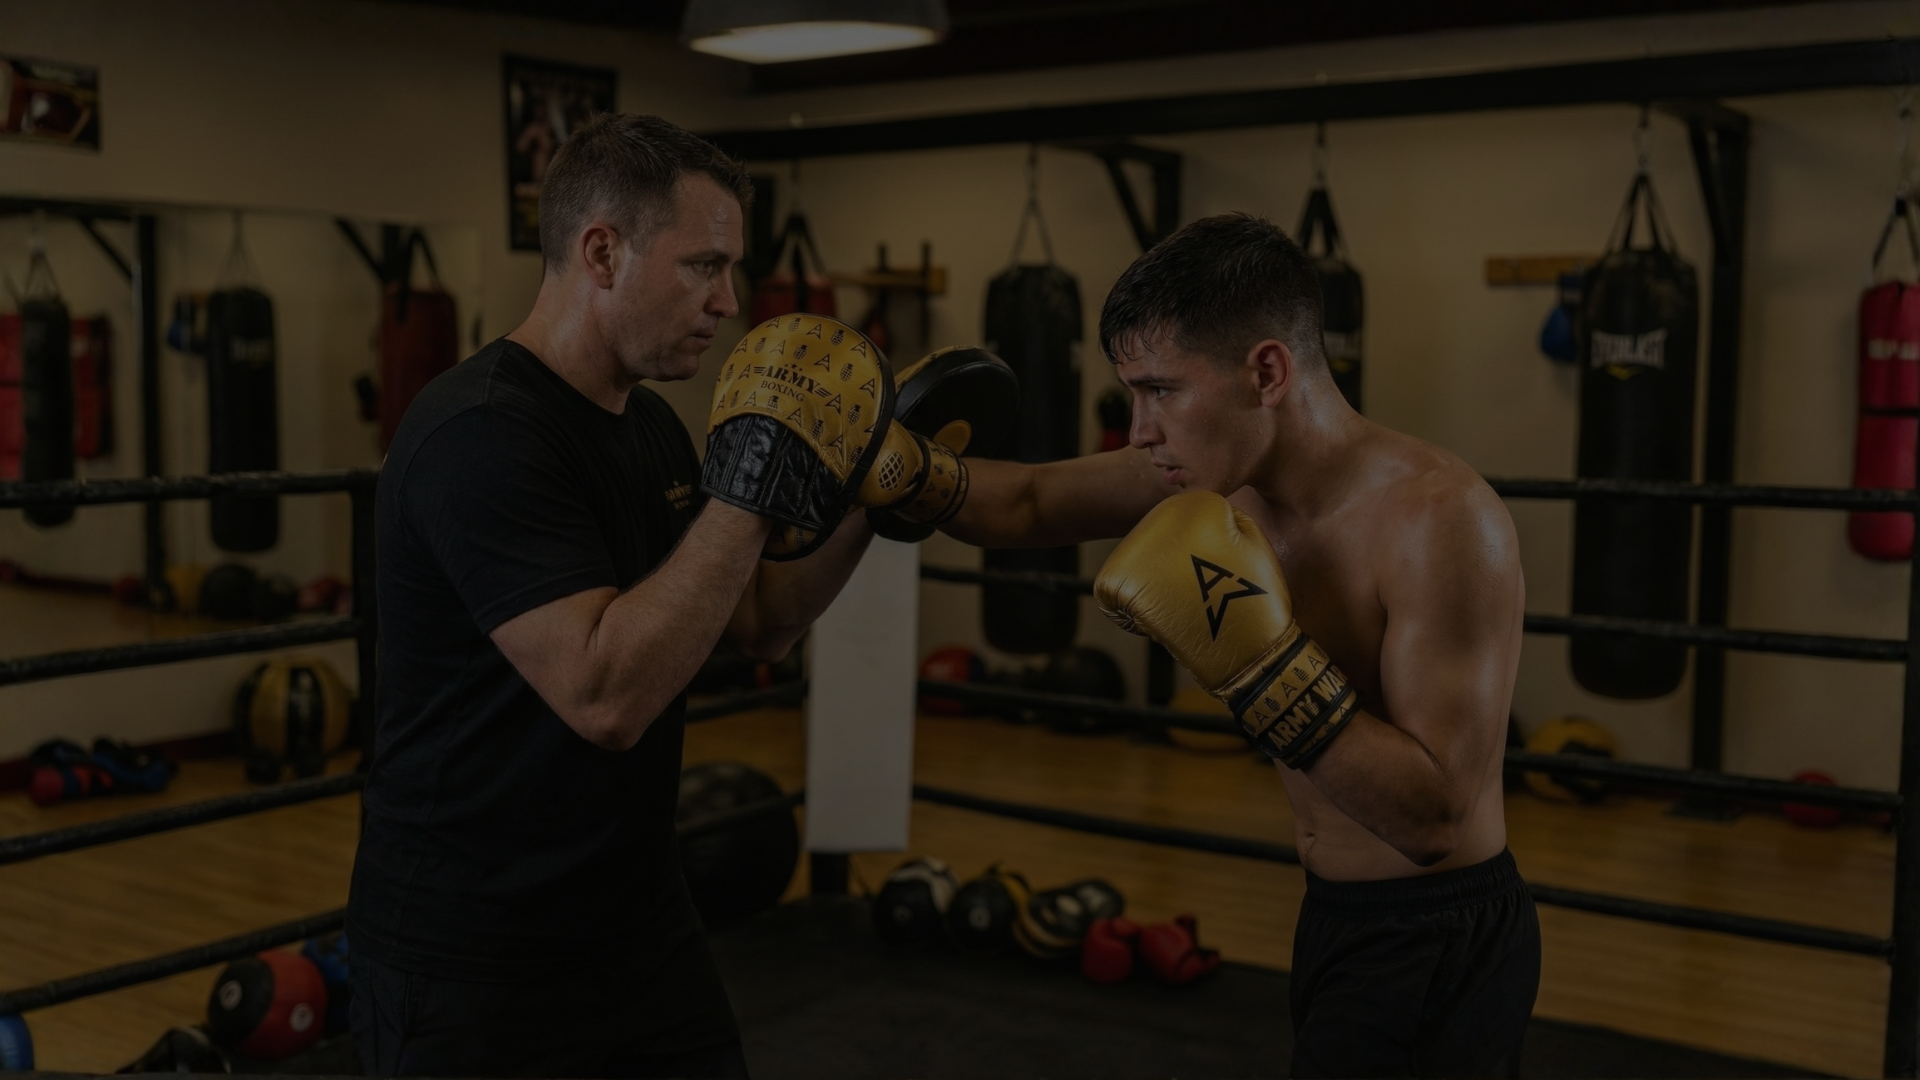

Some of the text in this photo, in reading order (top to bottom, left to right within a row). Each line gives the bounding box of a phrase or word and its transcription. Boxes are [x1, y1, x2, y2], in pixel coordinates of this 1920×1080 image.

[761, 365, 821, 395] ARMY
[761, 380, 806, 402] BOXING
[1268, 693, 1320, 751] ARMY
